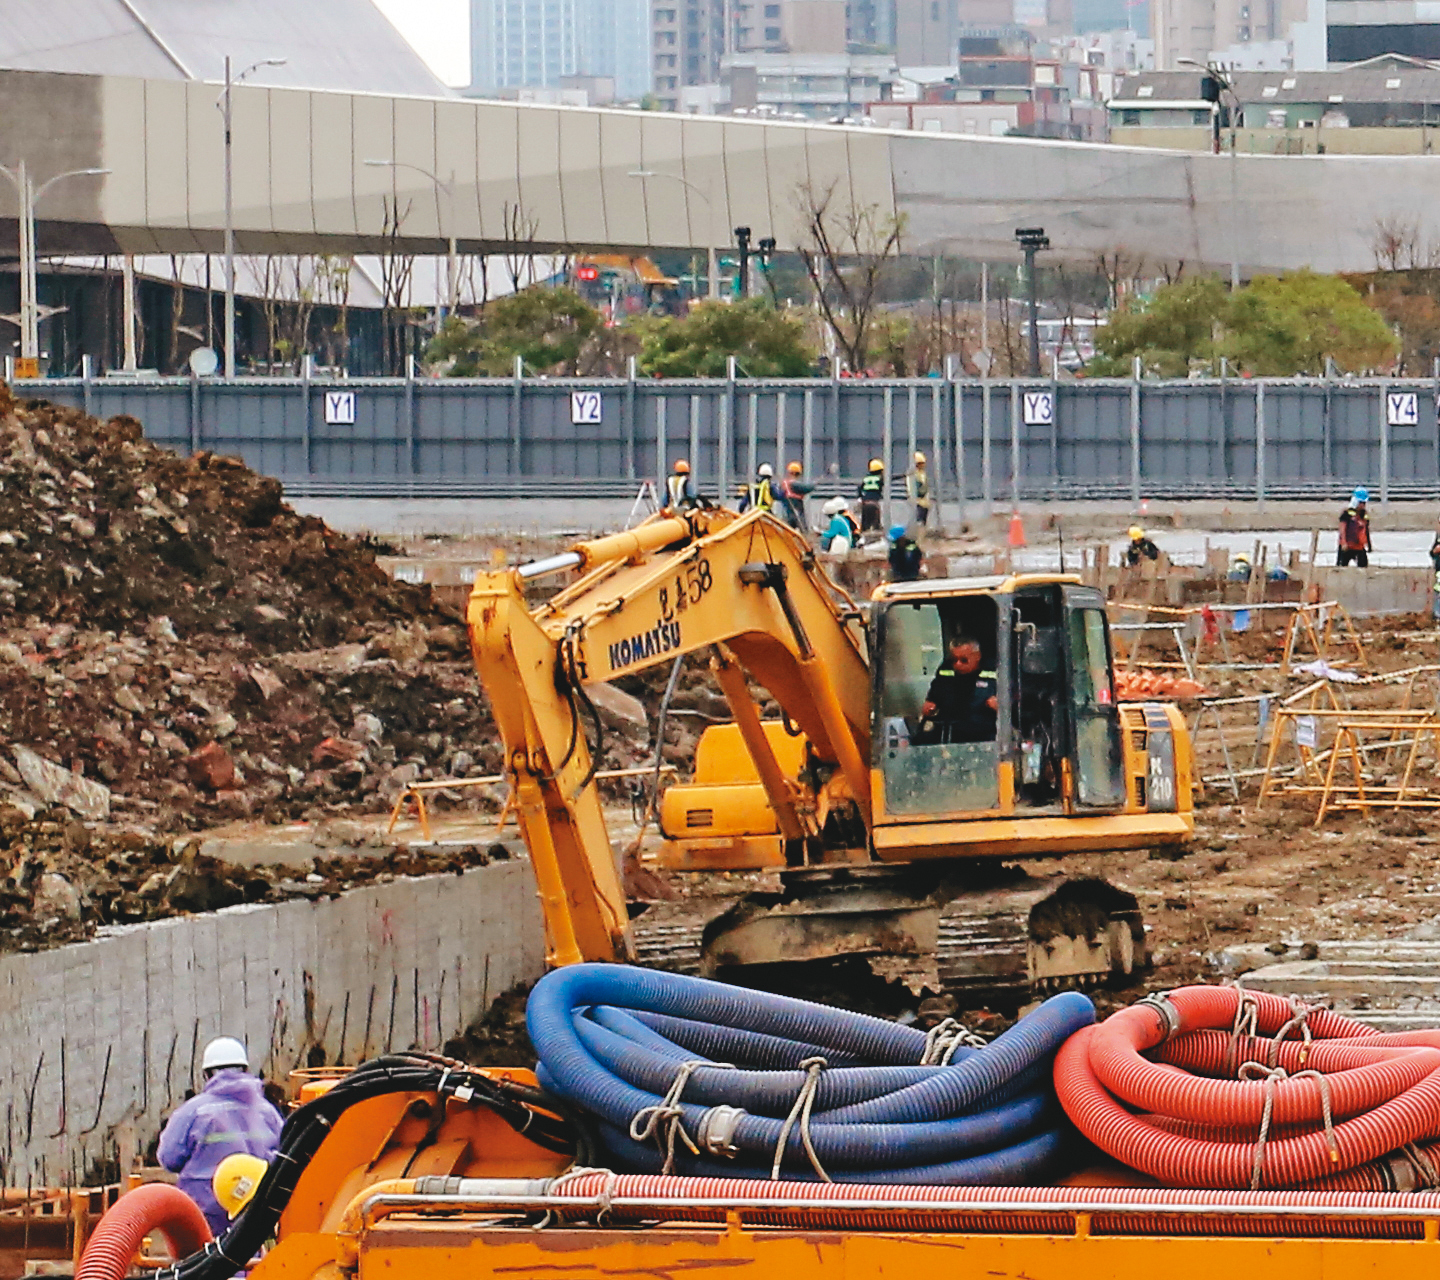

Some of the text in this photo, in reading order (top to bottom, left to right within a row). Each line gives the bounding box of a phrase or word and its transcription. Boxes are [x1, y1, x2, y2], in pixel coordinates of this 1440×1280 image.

[329, 395, 353, 422] Y1
[575, 395, 599, 422] Y2
[1027, 395, 1051, 422] Y3
[1391, 396, 1416, 423] Y4
[609, 619, 681, 671] KOMATSU
[1151, 776, 1172, 800] 210
